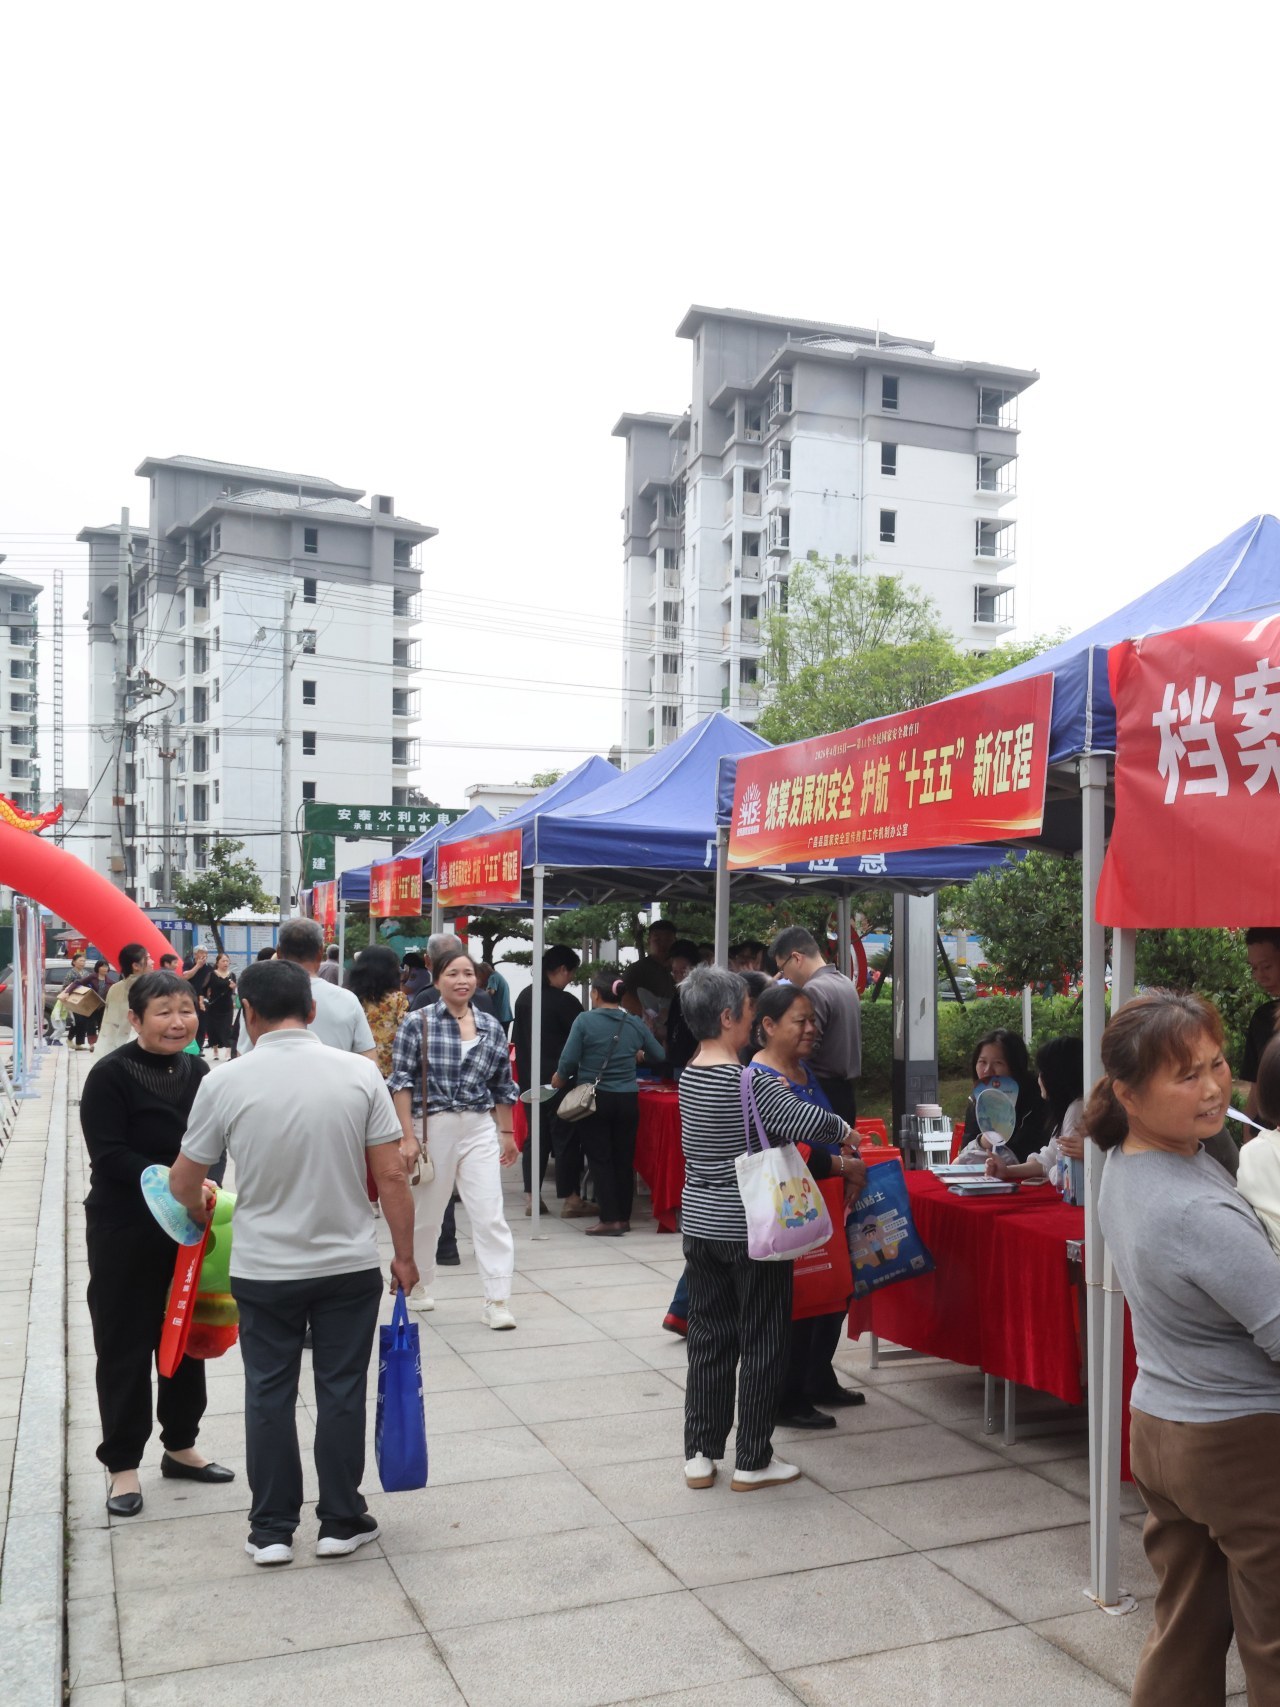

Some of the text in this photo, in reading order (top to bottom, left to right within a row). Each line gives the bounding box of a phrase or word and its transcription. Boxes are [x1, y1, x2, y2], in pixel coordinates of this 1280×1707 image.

[763, 722, 1035, 831] 统筹发展和安全 护航 “十五五” 新征程
[312, 857, 326, 870] 建
